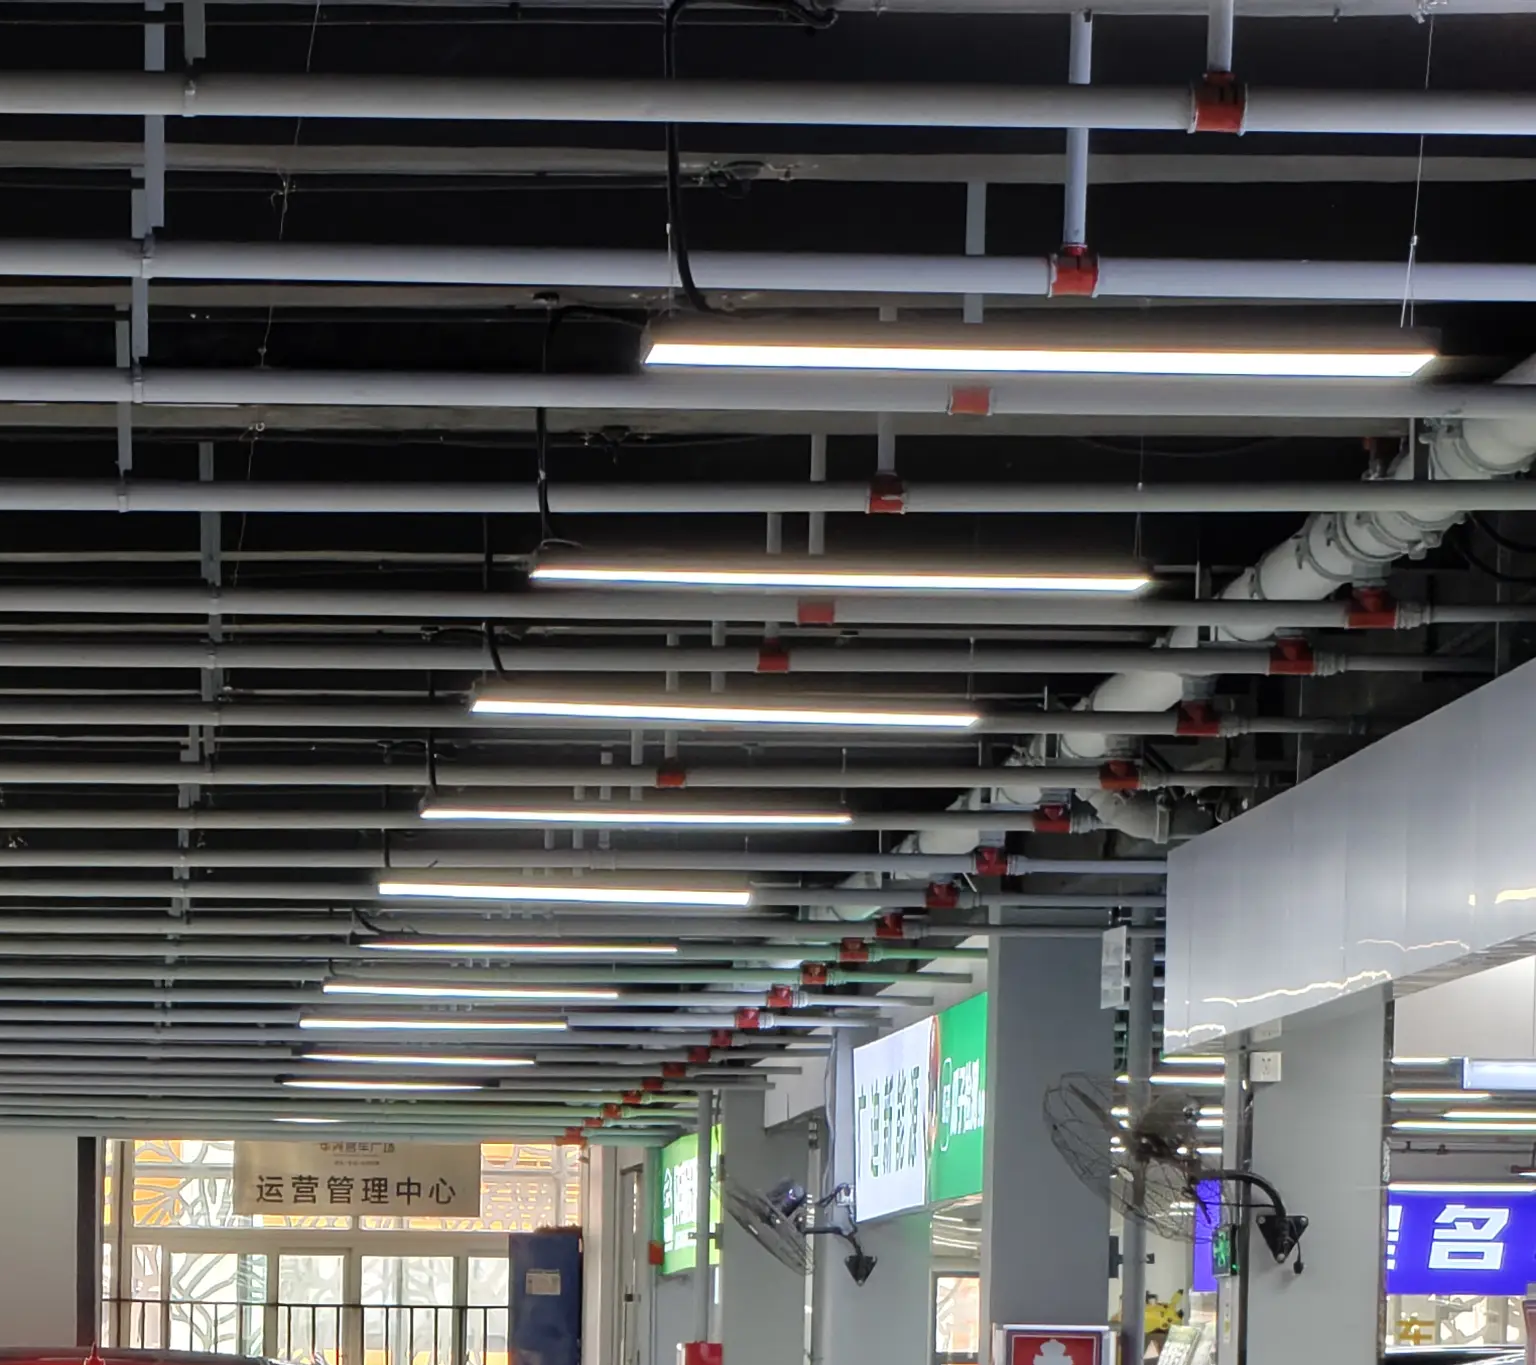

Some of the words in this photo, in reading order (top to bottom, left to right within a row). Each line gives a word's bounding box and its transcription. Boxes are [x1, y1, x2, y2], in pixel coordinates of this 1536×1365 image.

[255, 1174, 456, 1206] 运营管理中心
